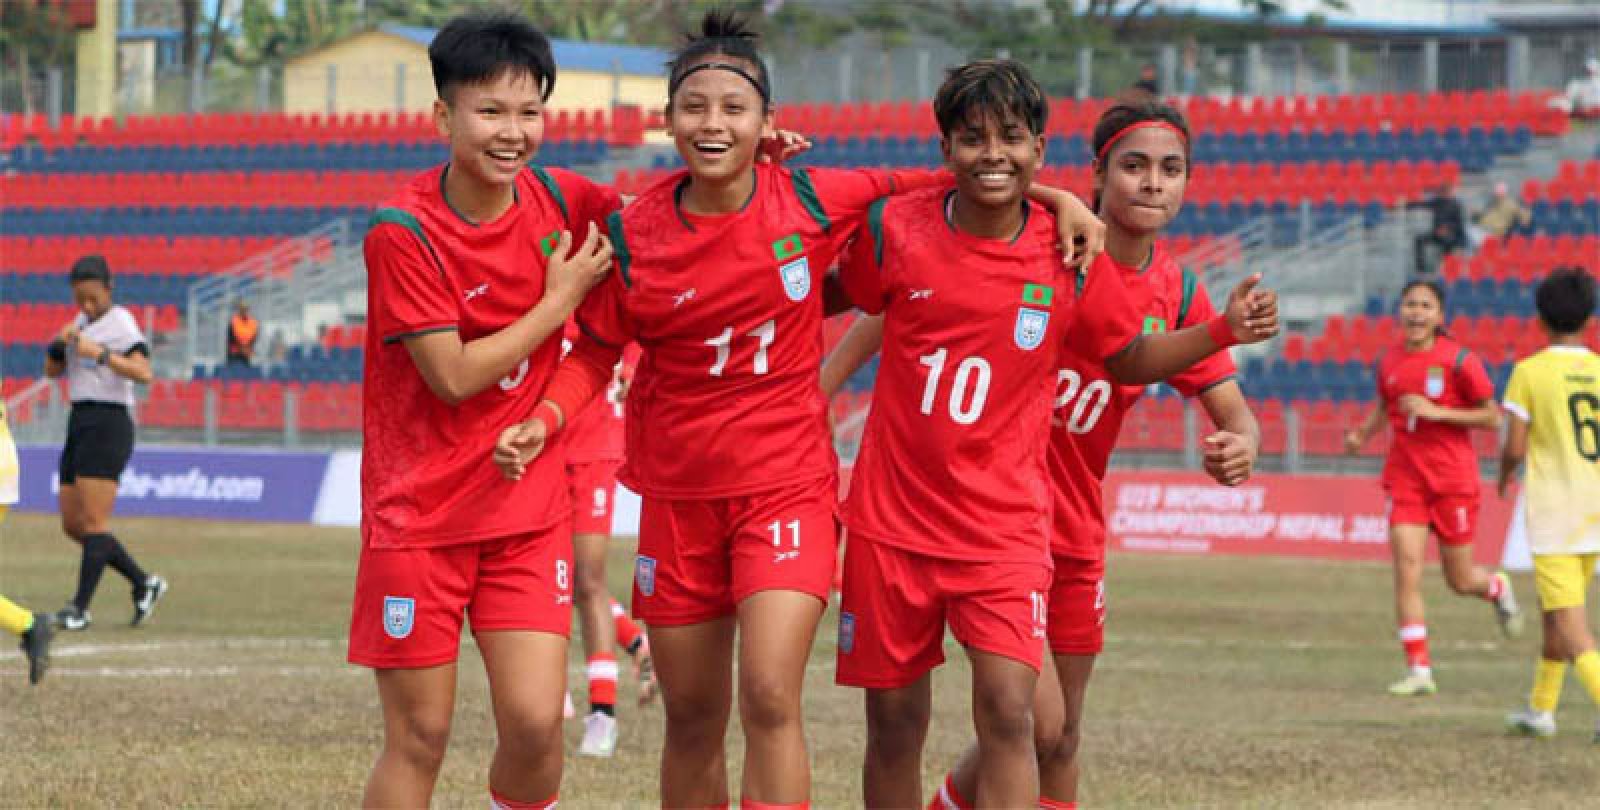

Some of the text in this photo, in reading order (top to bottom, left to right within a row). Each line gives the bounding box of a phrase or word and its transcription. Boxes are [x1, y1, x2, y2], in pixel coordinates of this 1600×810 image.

[704, 319, 776, 377] 11
[919, 348, 992, 425] 10
[1053, 368, 1113, 434] 20
[1568, 392, 1600, 462] 6
[768, 520, 801, 547] 11
[1109, 510, 1389, 543] CHAMPIONSHIP NEPAL 202
[555, 559, 569, 590] 8
